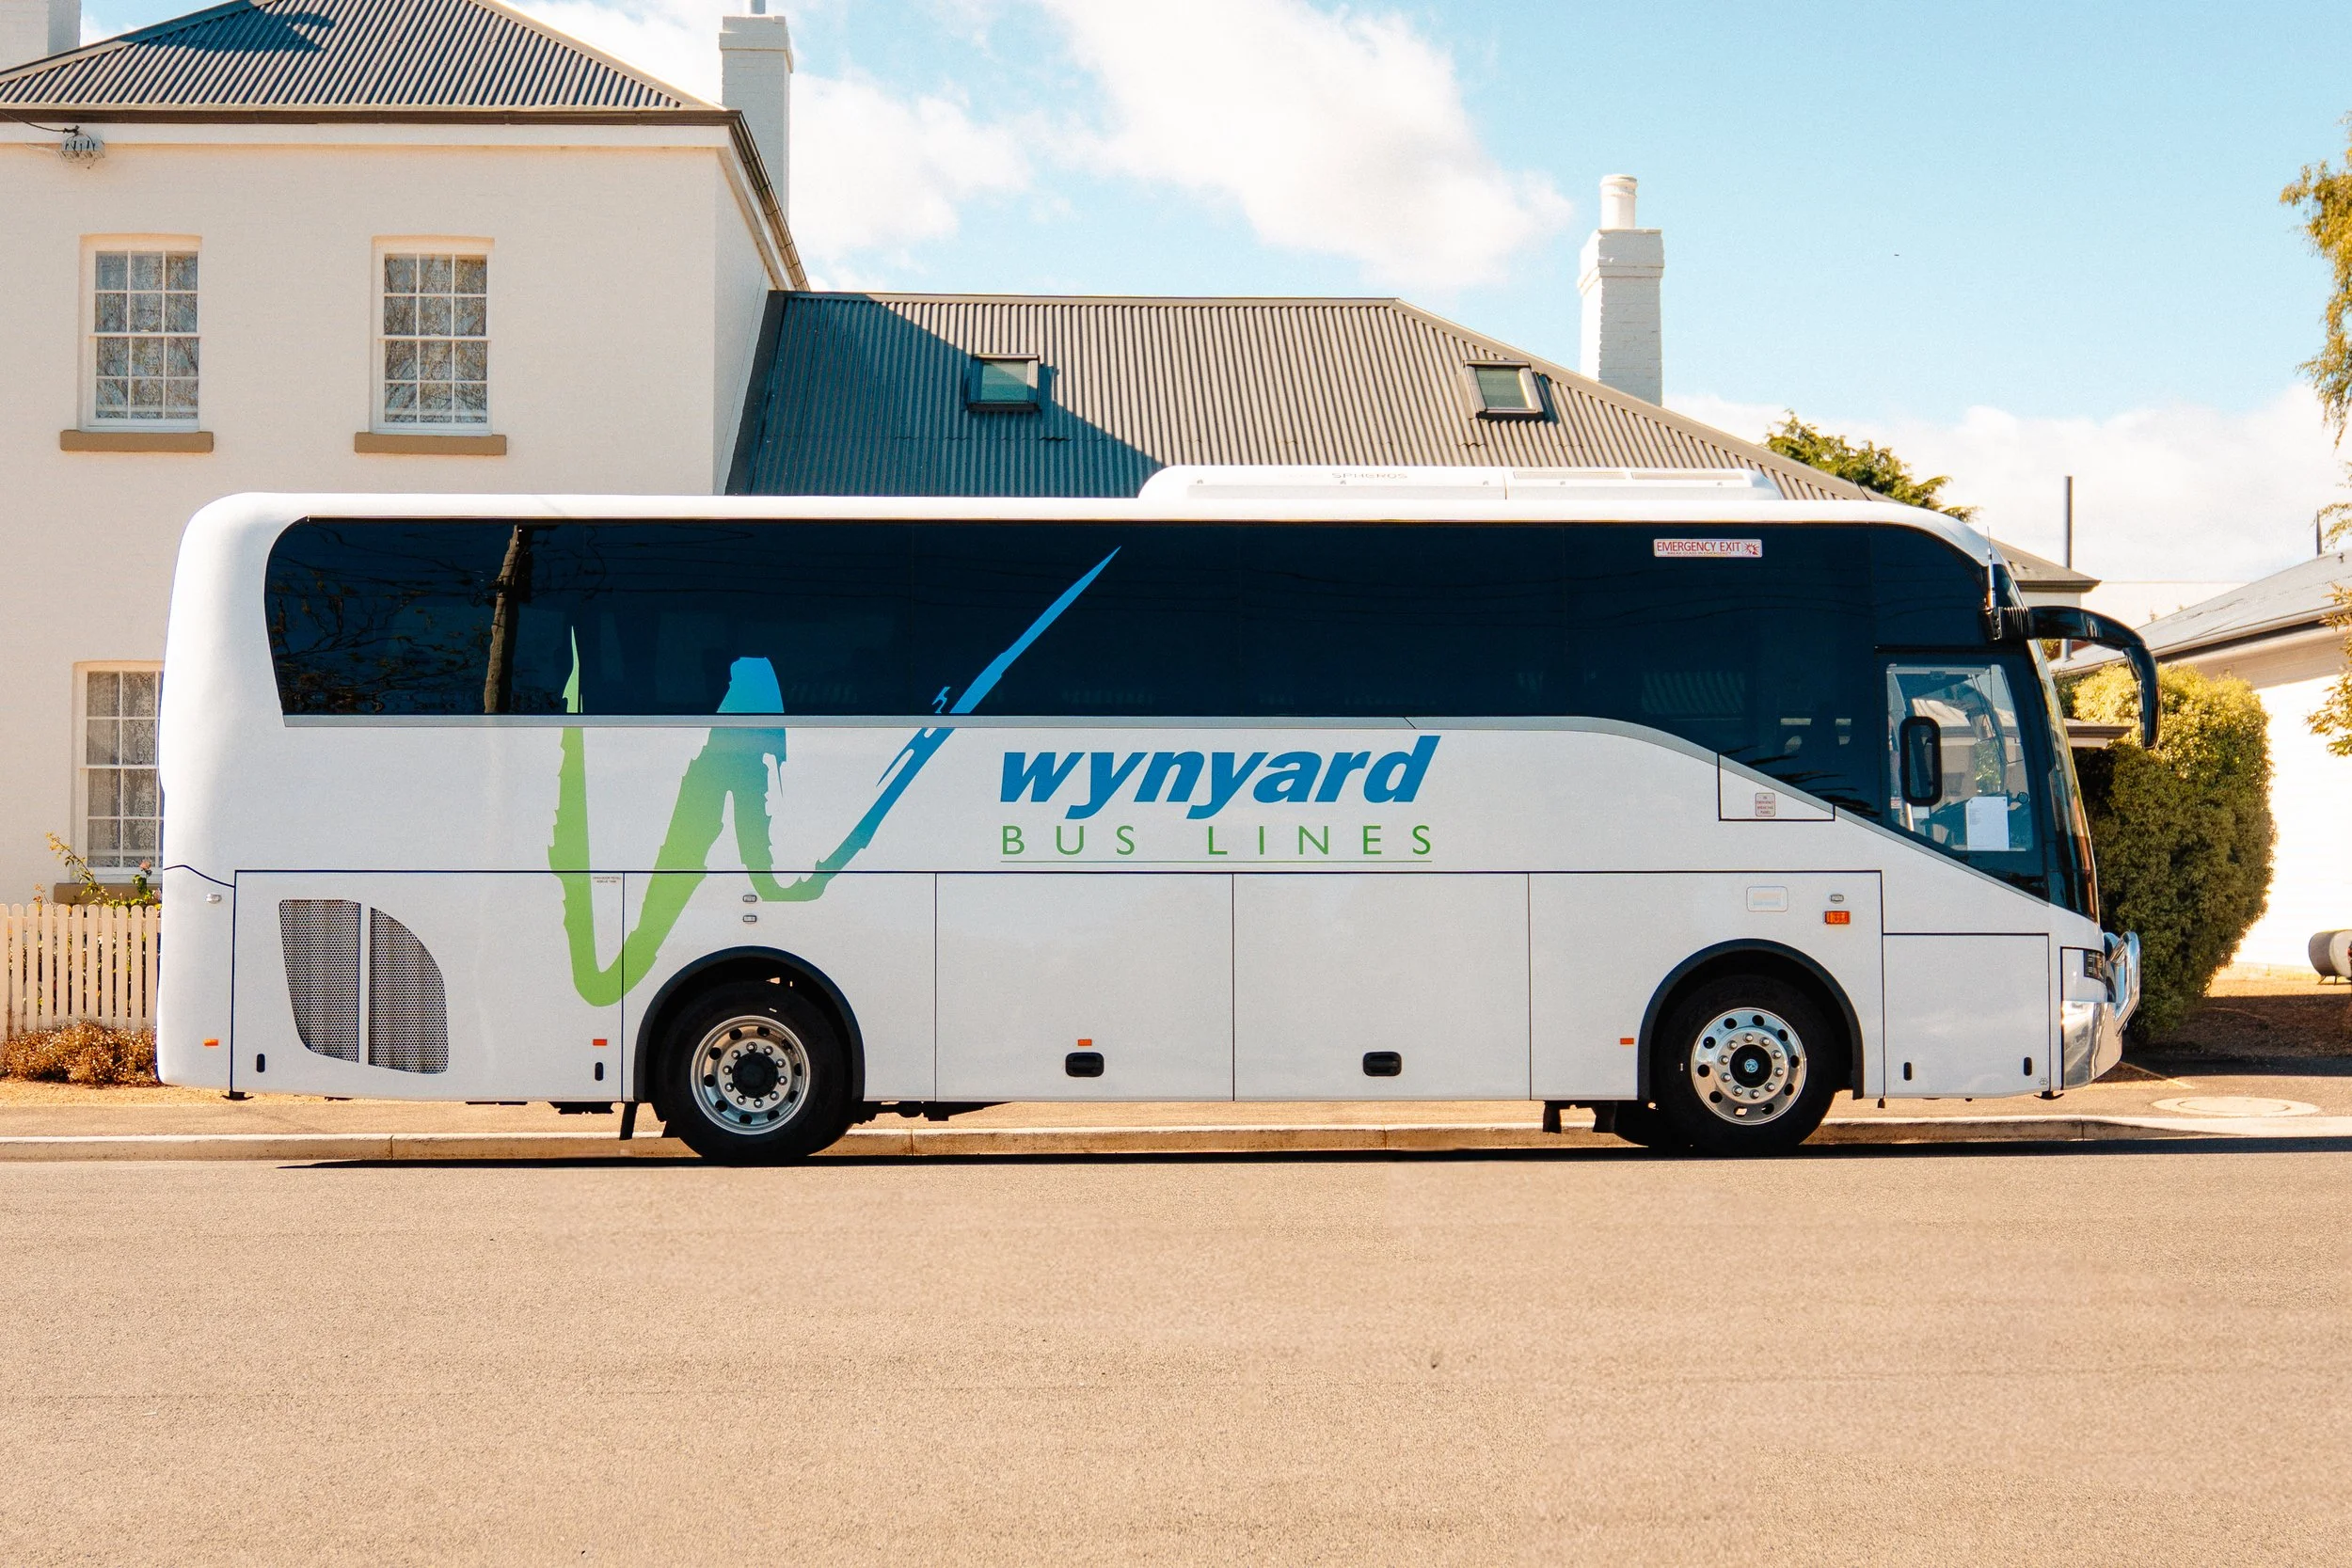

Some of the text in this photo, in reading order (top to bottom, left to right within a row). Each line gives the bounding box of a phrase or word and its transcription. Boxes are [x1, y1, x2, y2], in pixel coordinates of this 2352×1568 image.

[1657, 541, 1741, 552] EMERGENCY EXIT
[999, 735, 1442, 820] wynyard
[1002, 825, 1433, 855] BUS LINES
